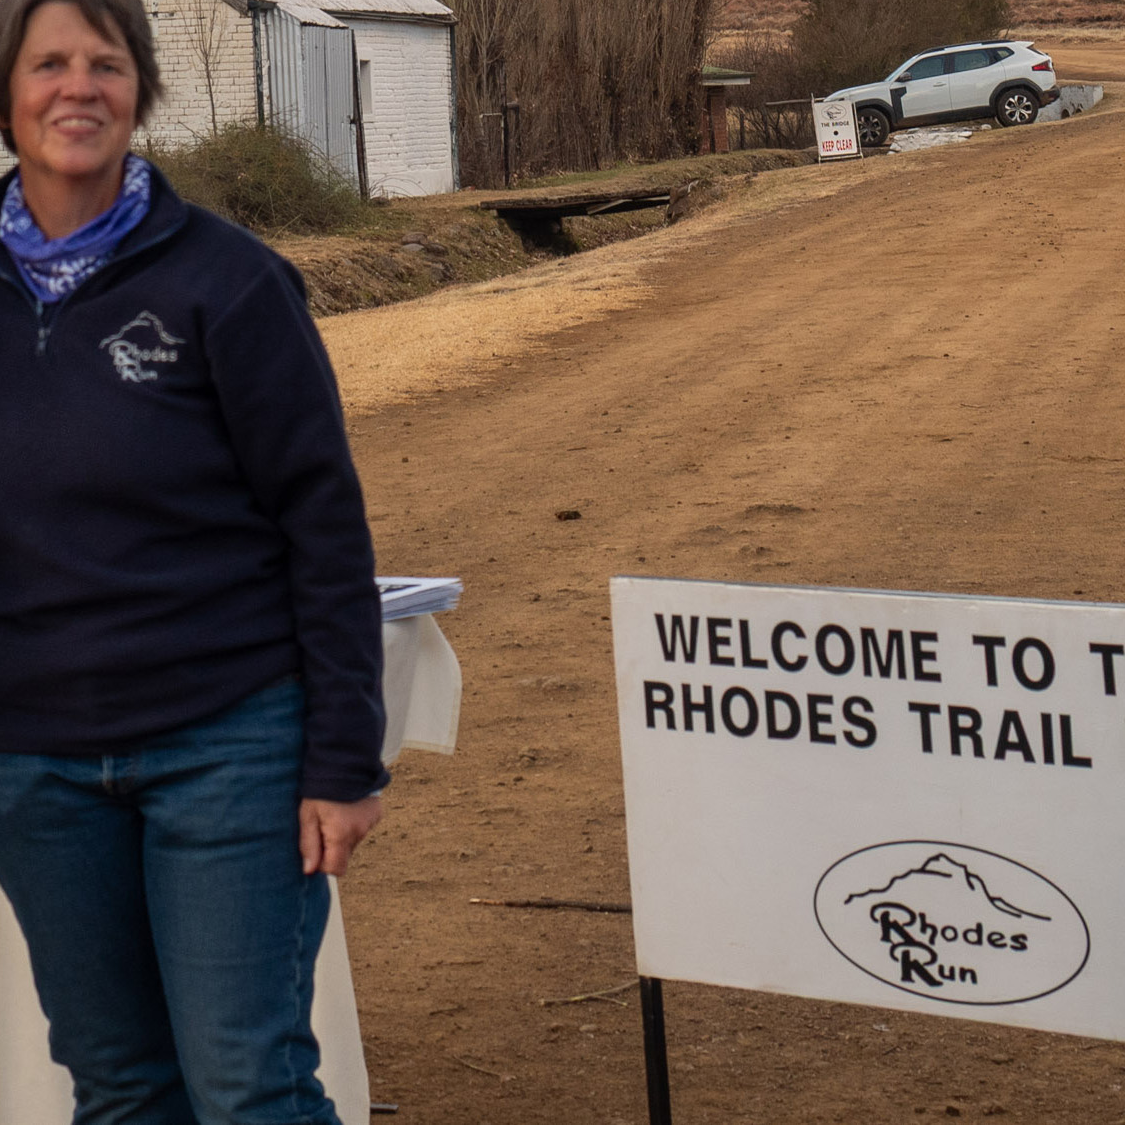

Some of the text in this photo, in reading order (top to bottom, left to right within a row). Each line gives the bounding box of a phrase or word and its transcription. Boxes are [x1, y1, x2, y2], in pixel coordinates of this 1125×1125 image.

[822, 139, 852, 152] KEEP CLEAR
[109, 340, 178, 366] Rhodes
[655, 613, 943, 684] WELCOME
[973, 634, 1056, 692] TO
[643, 680, 1093, 768] RHODES TRAIL
[870, 902, 1028, 951] Rhodes
[889, 941, 978, 987] Run
